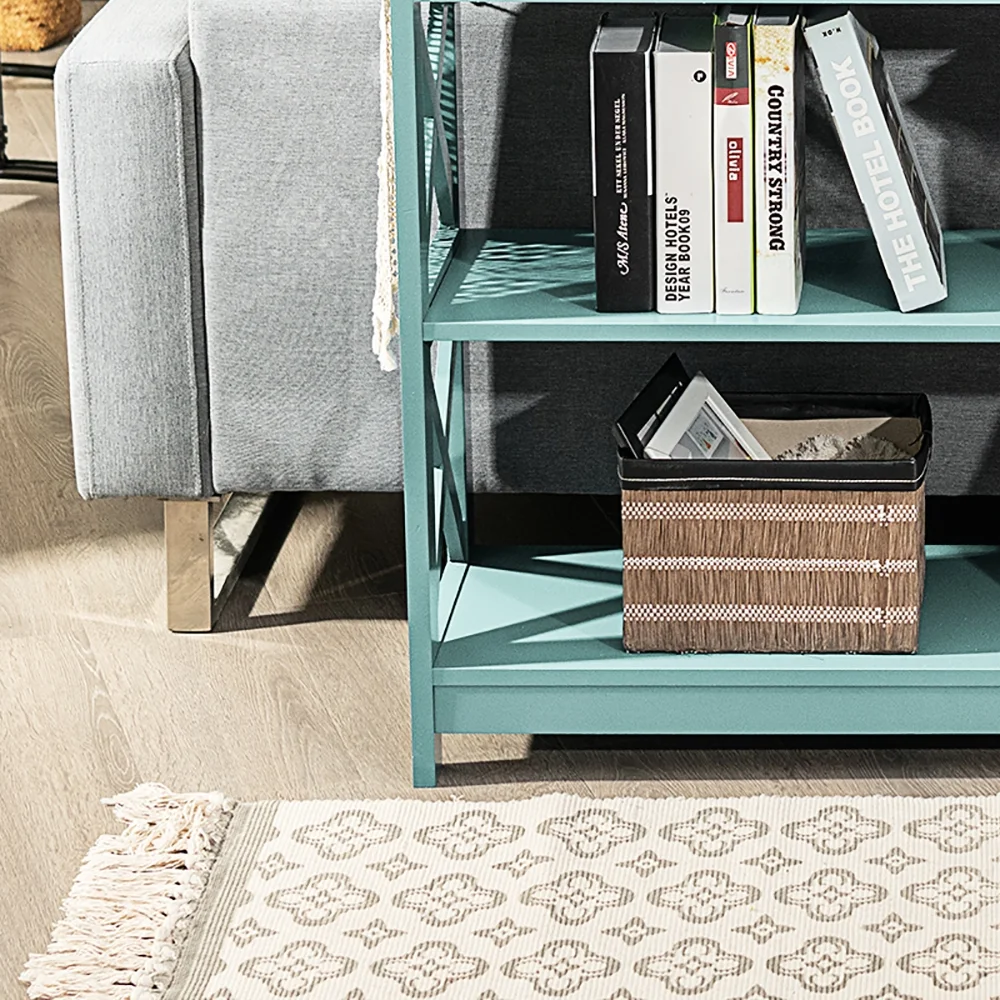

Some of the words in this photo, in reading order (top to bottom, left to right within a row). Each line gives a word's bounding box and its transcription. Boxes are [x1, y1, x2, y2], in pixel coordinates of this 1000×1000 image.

[767, 84, 785, 174] COUNTRY
[831, 55, 876, 139] BOOK
[728, 140, 742, 181] olivia
[863, 140, 909, 233] HOTEL
[768, 178, 786, 251] STRONG
[664, 253, 678, 302] DESIGN
[678, 266, 691, 302] YEAR
[892, 234, 927, 293] THE
